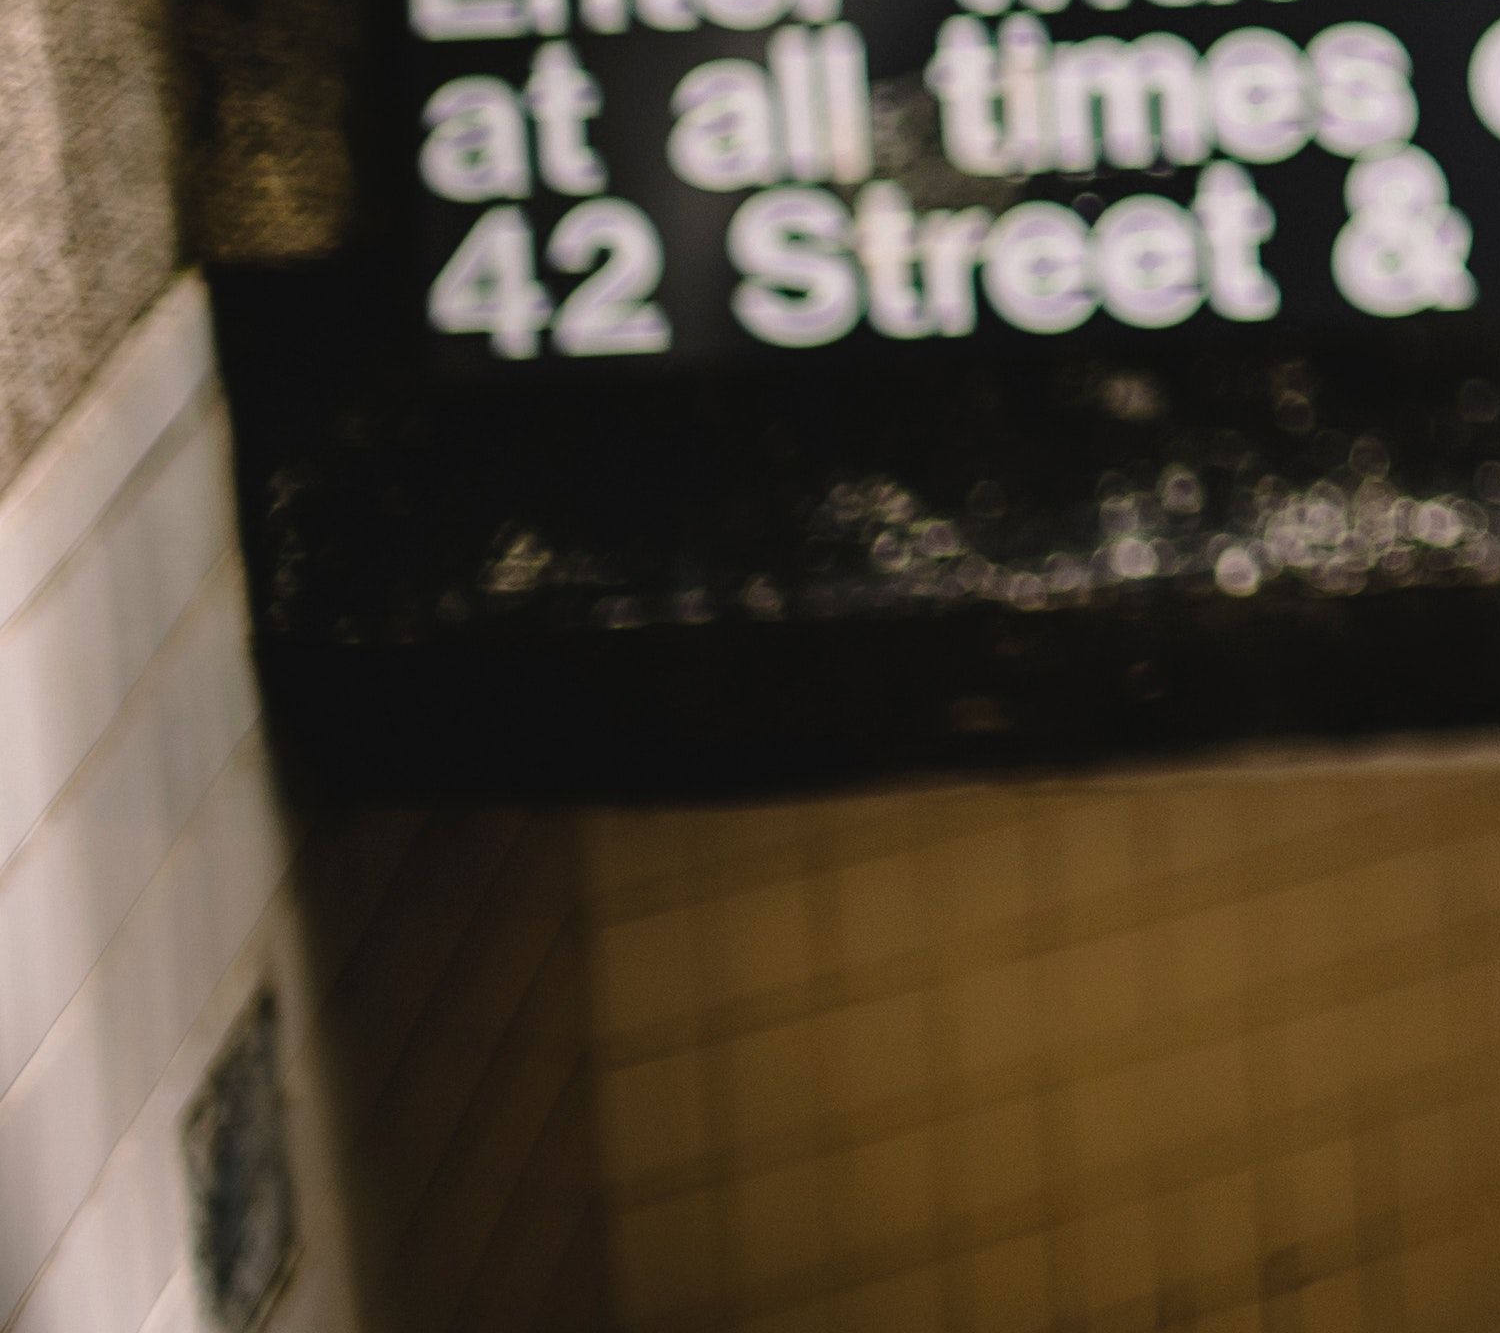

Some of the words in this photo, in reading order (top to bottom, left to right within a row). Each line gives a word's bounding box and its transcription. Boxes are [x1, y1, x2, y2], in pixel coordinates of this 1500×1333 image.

[421, 38, 606, 202] at
[668, 21, 873, 192] all
[927, 12, 1418, 177] times
[427, 197, 673, 360] 42
[726, 160, 1280, 347] Street
[1331, 142, 1479, 317] &
